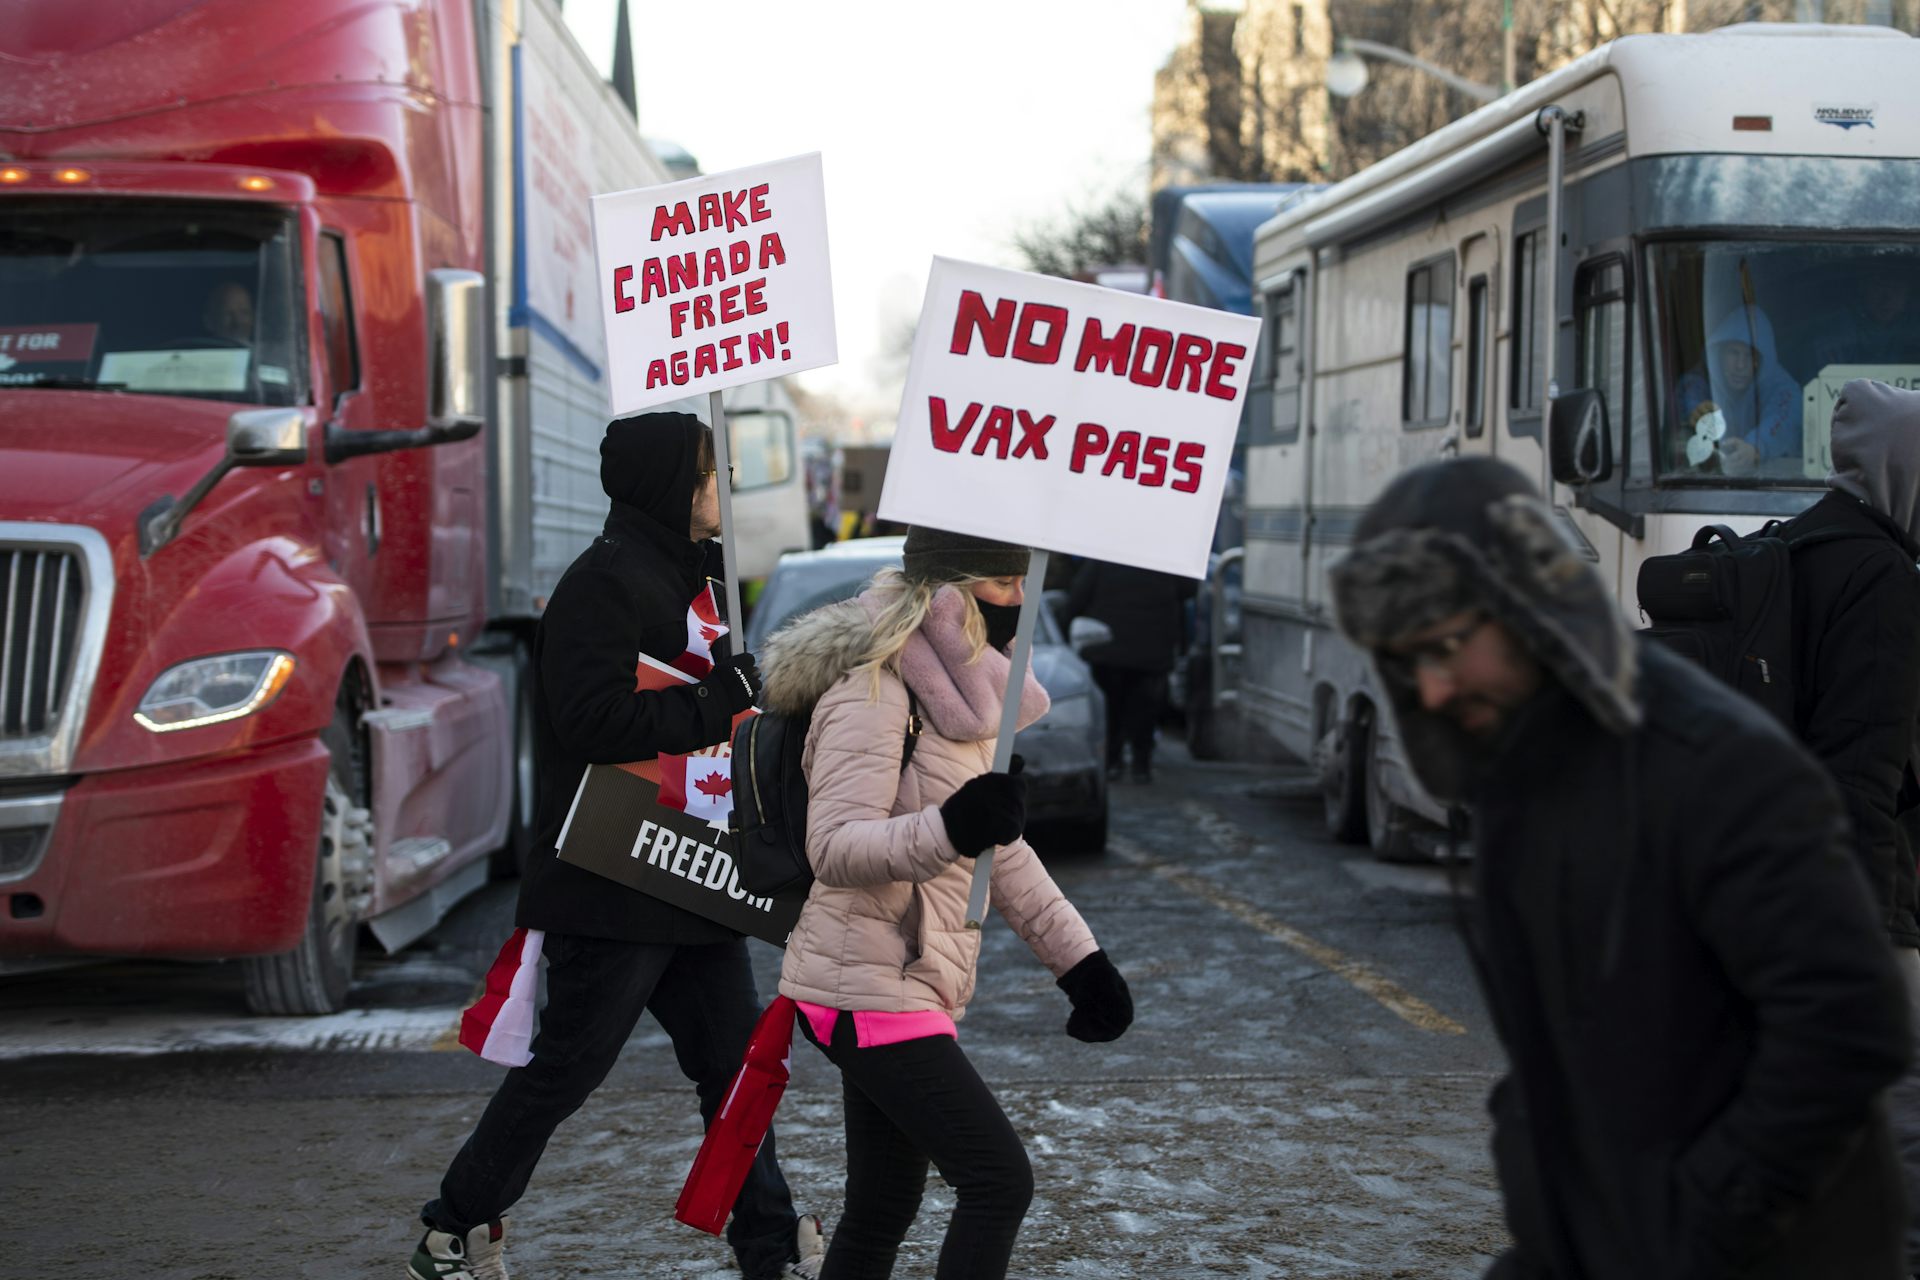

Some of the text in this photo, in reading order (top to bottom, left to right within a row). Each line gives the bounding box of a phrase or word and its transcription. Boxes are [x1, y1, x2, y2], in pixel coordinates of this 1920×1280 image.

[651, 183, 771, 241] MAKE
[614, 232, 786, 314] CANADA
[17, 332, 60, 350] FOR
[670, 277, 768, 338] FREE
[646, 321, 790, 389] AGAIN!
[950, 290, 1246, 401] NO MORE
[928, 396, 1205, 494] VAX PASS
